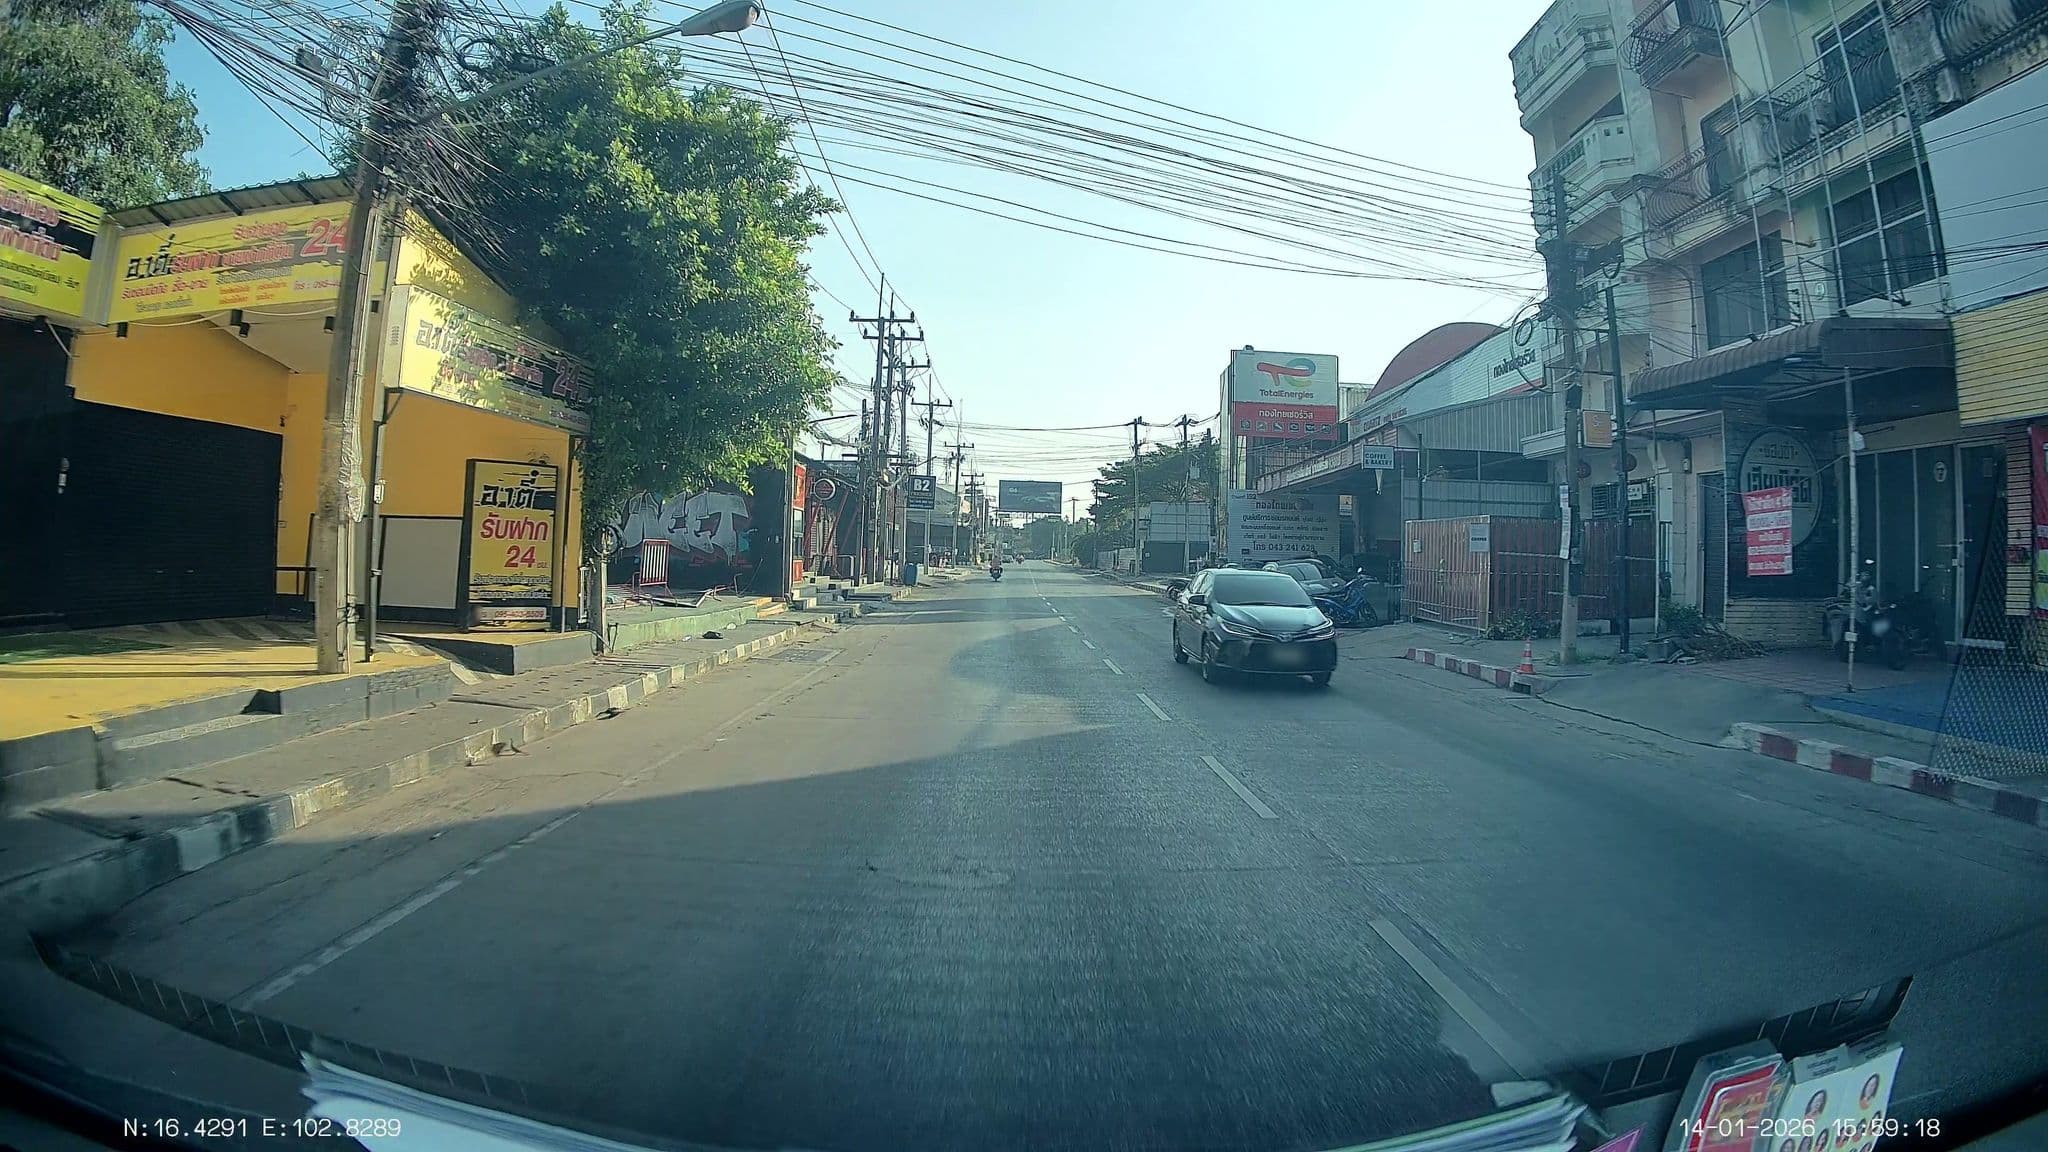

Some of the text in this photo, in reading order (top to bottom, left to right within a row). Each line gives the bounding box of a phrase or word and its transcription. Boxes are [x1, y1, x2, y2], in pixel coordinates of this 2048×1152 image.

[302, 217, 347, 255] 24
[1259, 389, 1314, 399] TotalEnergies
[913, 478, 930, 492] B2
[480, 512, 549, 541] รับฝาก
[504, 545, 536, 568] 24
